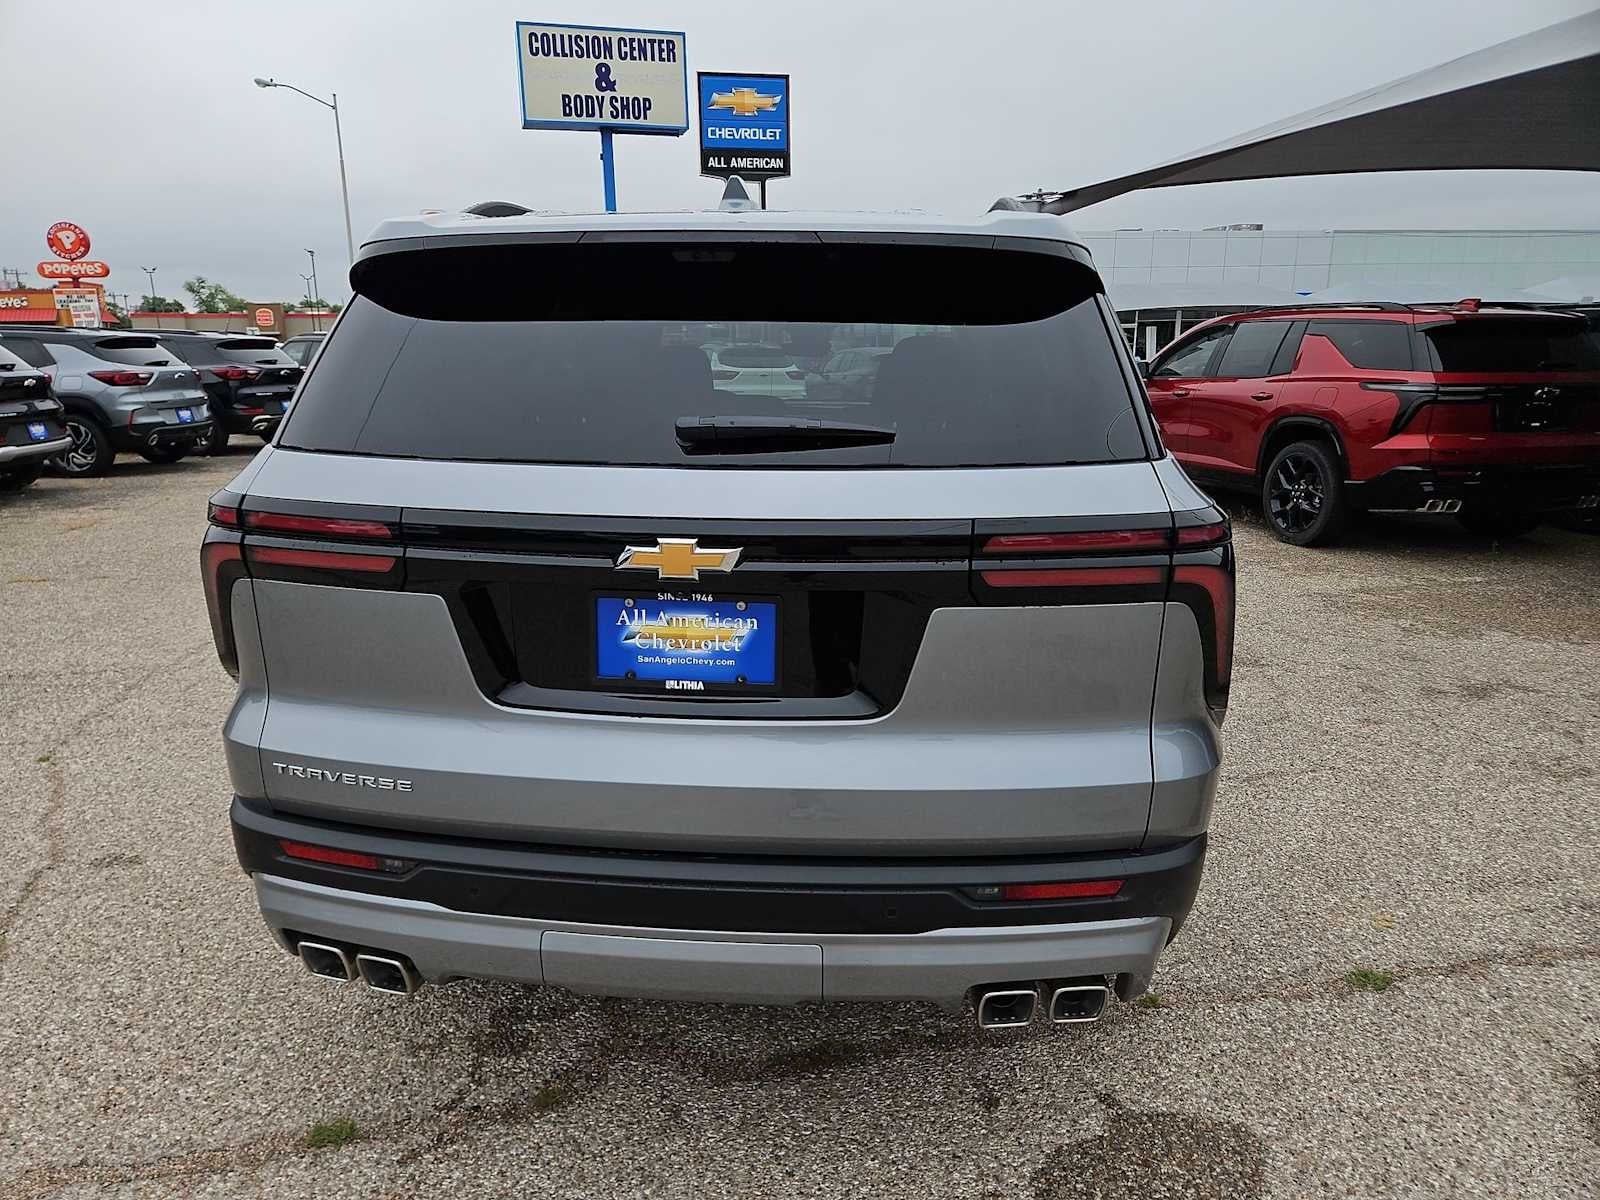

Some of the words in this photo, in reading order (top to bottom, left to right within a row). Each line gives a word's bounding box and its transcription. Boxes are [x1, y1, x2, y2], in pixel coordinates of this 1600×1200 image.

[528, 31, 613, 60] COLLISION
[617, 36, 677, 63] CENTER
[594, 62, 617, 92] &
[561, 93, 605, 119] BODY
[609, 95, 653, 121] SHOP
[707, 127, 782, 141] CHEVROLET
[707, 156, 728, 168] ALL
[730, 157, 784, 169] AMERICAN
[657, 592, 689, 601] SIN
[691, 593, 714, 602] 1946
[615, 608, 647, 626] All
[655, 610, 758, 630] American
[635, 632, 741, 652] Chevrolet
[637, 655, 736, 667] SanAngeloChevy.com
[674, 680, 705, 691] LITHIA
[272, 762, 414, 792] TRAVERSE
